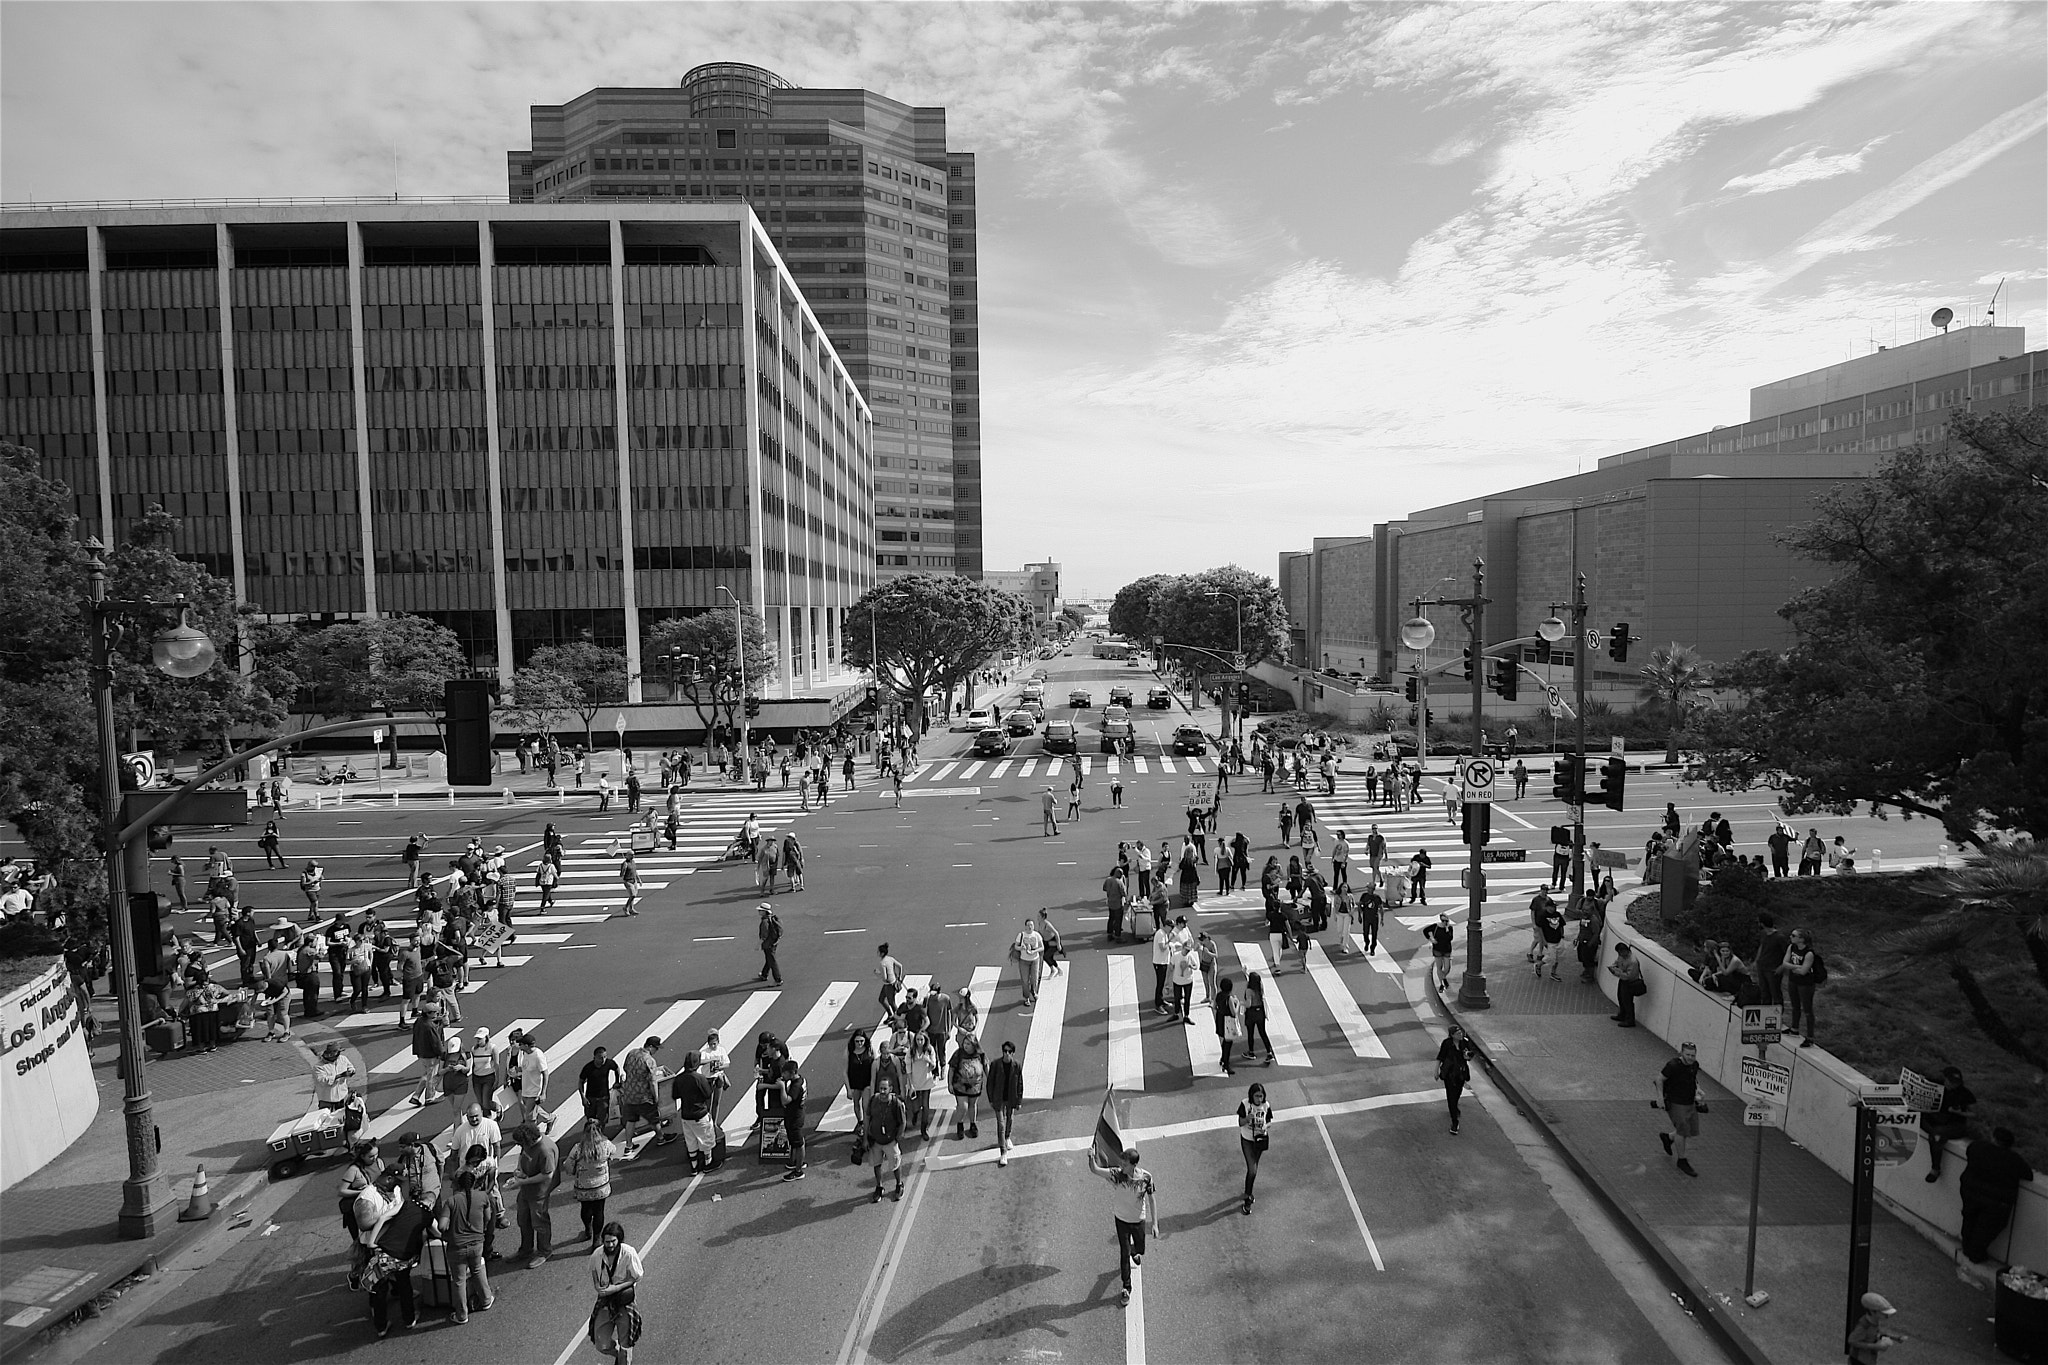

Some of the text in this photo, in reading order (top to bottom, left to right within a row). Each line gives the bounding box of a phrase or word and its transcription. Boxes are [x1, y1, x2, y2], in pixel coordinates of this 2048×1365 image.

[1466, 791, 1492, 799] ON RED
[1495, 850, 1519, 860] Angeles
[20, 985, 52, 1012] Fletcher
[1750, 1033, 1780, 1043] 636-RIDE
[16, 1026, 71, 1076] Shops and
[1743, 1063, 1788, 1085] NO STOPPING
[1745, 1076, 1786, 1095] ANY TIME
[1748, 1112, 1763, 1120] 785
[1876, 1114, 1917, 1125] DASH
